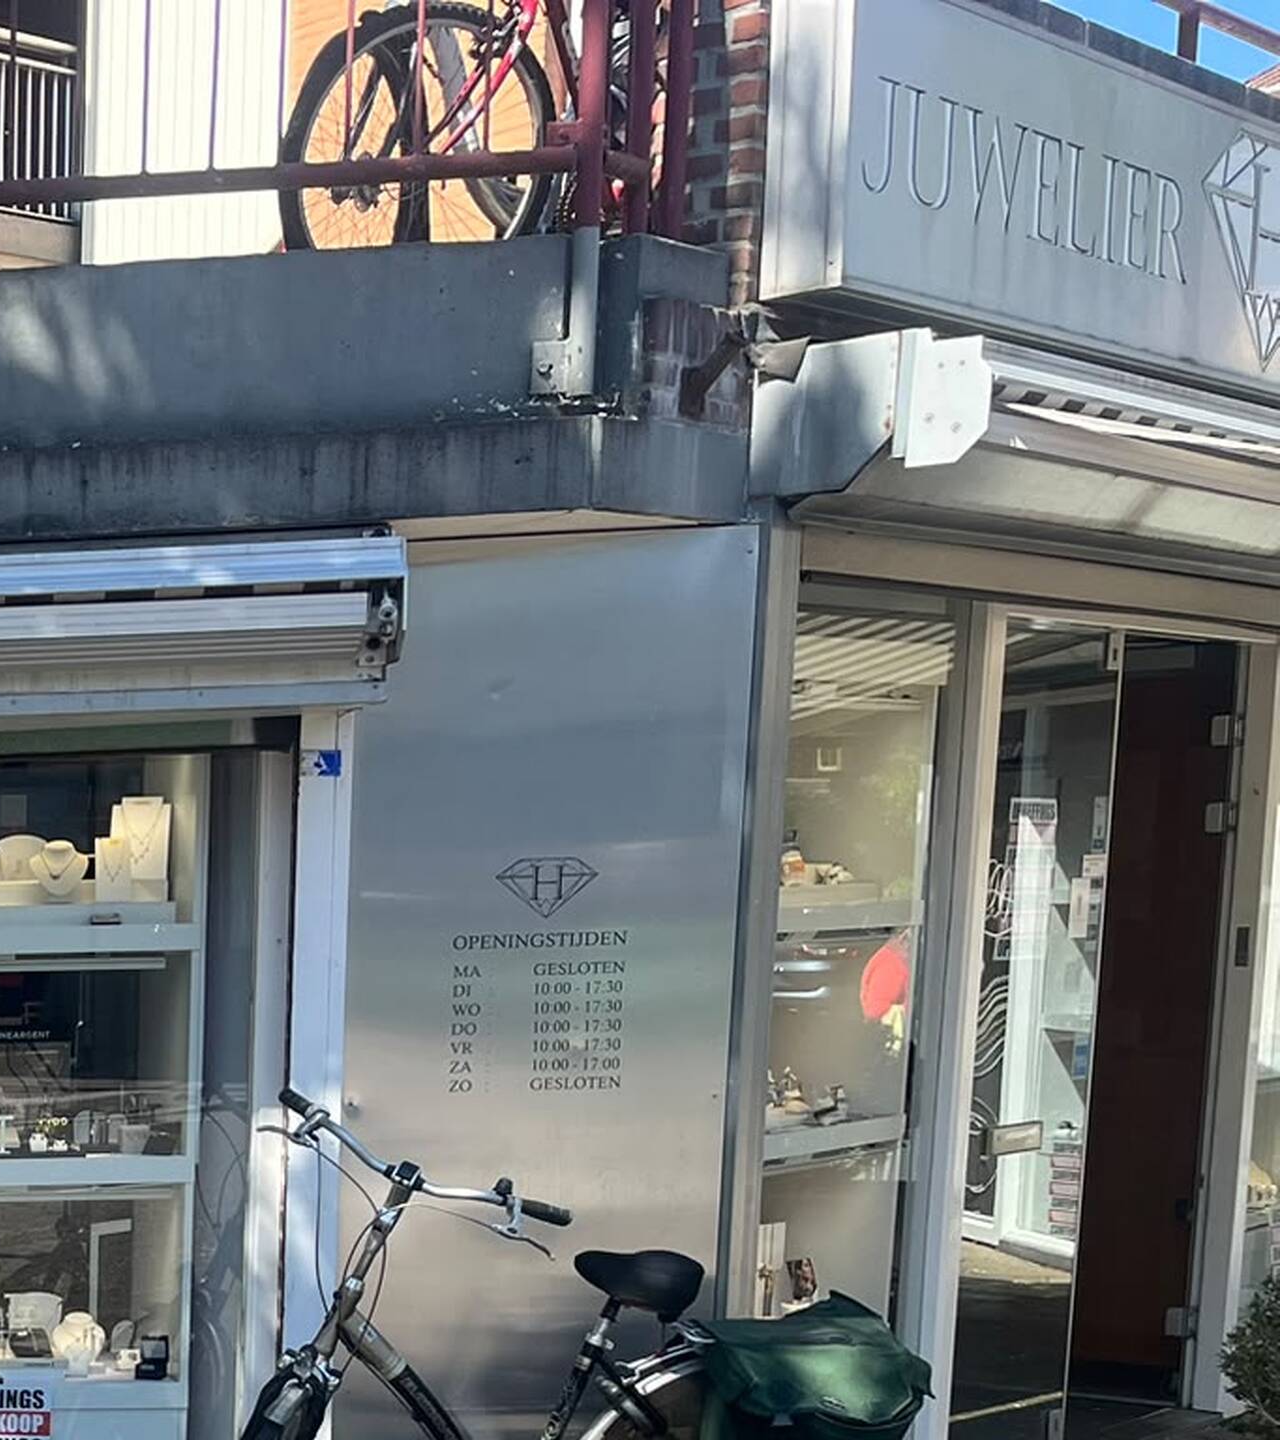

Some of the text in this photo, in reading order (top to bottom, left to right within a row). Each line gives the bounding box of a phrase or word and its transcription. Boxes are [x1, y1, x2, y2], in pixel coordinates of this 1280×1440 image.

[861, 75, 1187, 285] JUWELIER
[452, 930, 629, 951] OPENINGSTIJDEN
[453, 960, 626, 978] MA GESLOTEN
[452, 984, 472, 998] DI
[585, 980, 623, 995] 17:30
[452, 1003, 481, 1016] WO
[585, 999, 623, 1013] 17:30
[451, 1022, 477, 1036] DO
[584, 1018, 622, 1032] 17:30
[450, 1042, 473, 1054] VR
[584, 1037, 621, 1052] 17:30
[449, 1060, 472, 1074] ZA
[449, 1079, 473, 1093] ZO
[529, 1075, 621, 1091] GESLOTEN
